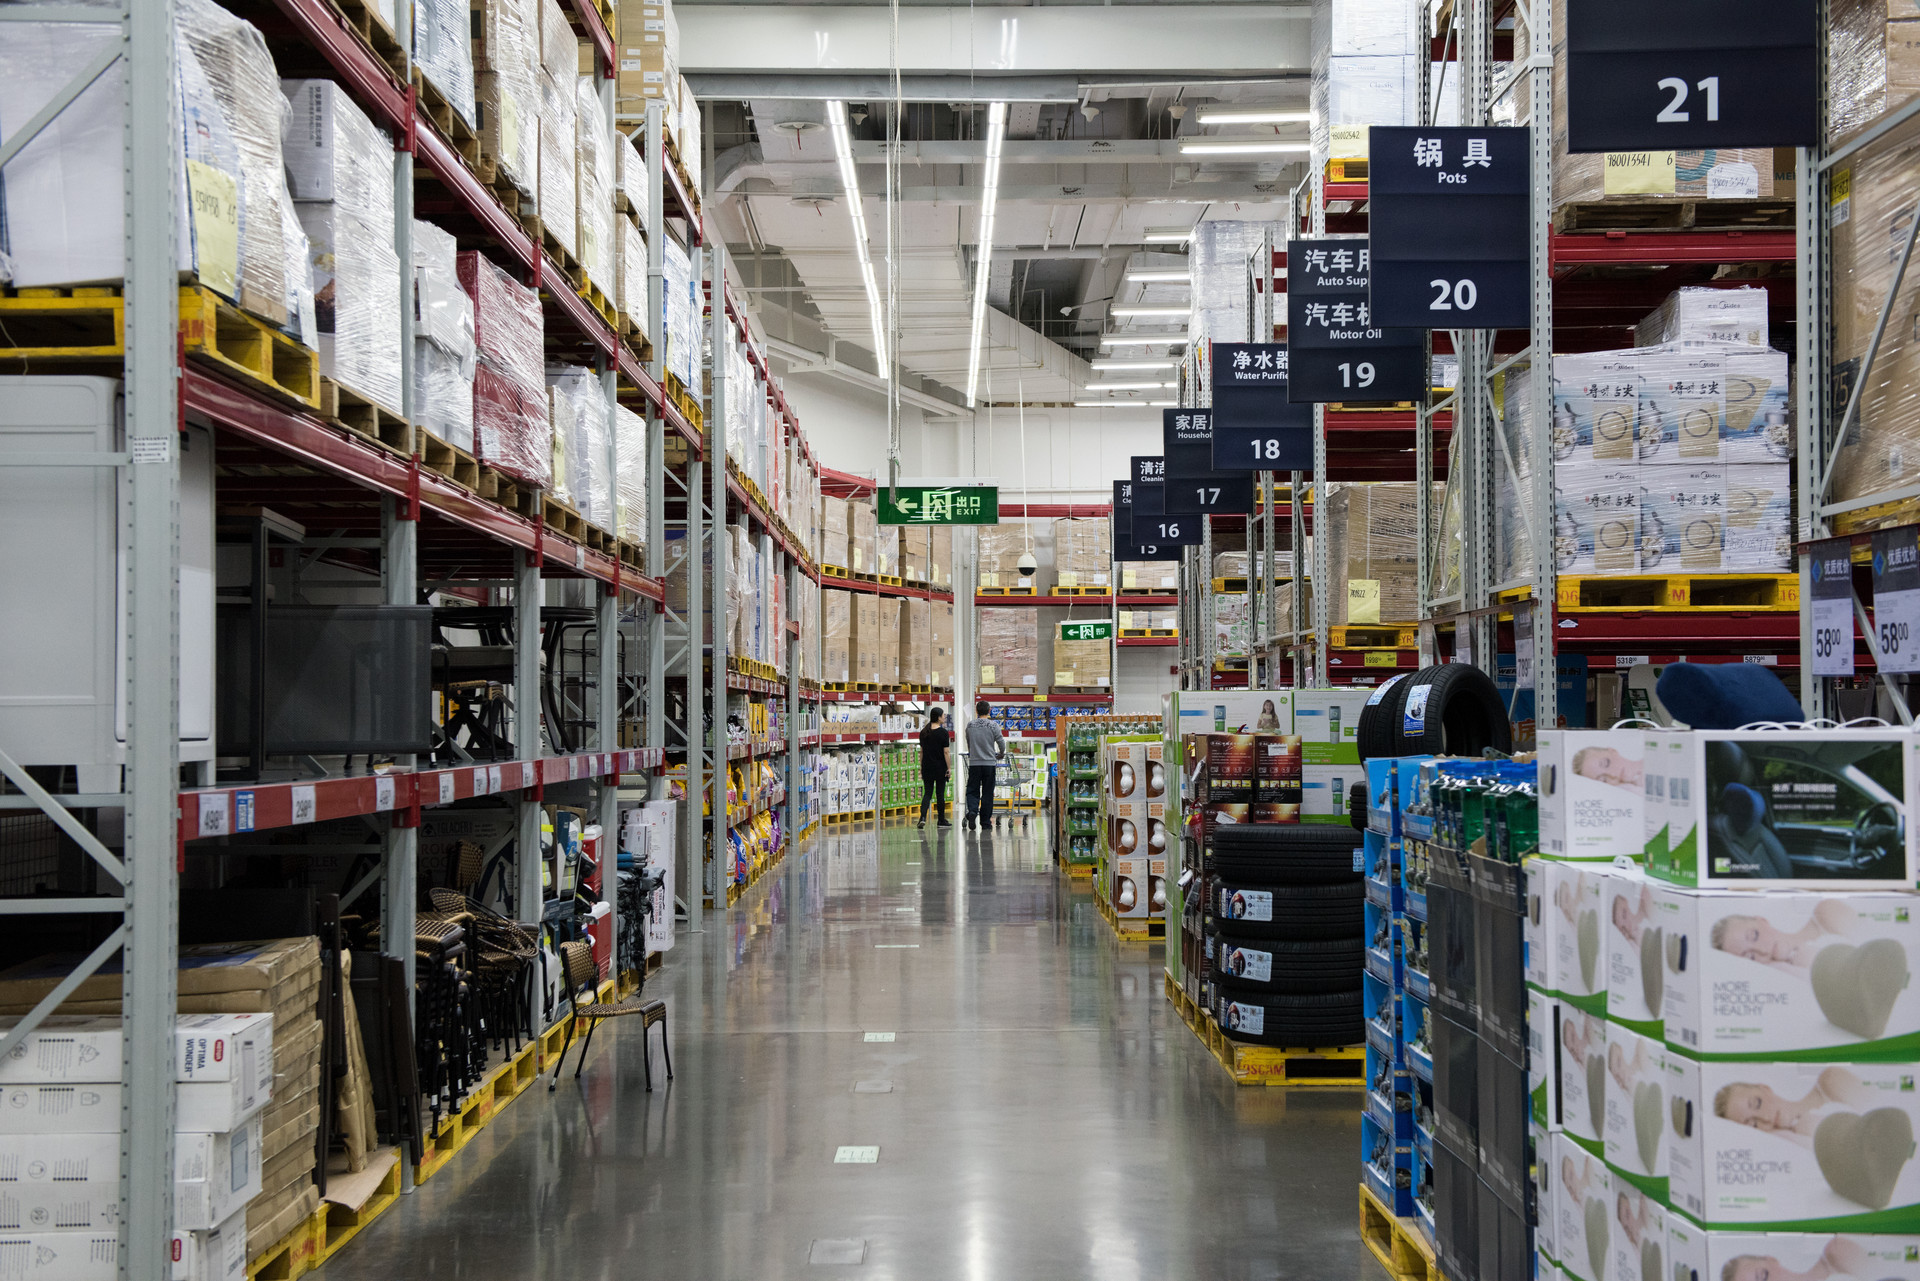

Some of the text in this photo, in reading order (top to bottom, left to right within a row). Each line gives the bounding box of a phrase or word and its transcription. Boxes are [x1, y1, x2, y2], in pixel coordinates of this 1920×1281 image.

[1657, 77, 1719, 122] 21
[1666, 154, 1674, 166] 6
[1438, 171, 1468, 184] Pots
[1317, 276, 1344, 286] Auto
[1429, 279, 1478, 311] 20
[1329, 328, 1382, 339] Motor Oil
[1235, 371, 1260, 380] Water
[1338, 362, 1376, 388] 19
[1175, 414, 1212, 431] 家居
[1251, 439, 1281, 460] 18
[956, 496, 981, 508] 出口
[1197, 487, 1221, 505] 17
[956, 508, 981, 516] EXIT
[1158, 523, 1180, 538] 16
[1672, 589, 1686, 602] M
[1574, 801, 1602, 809] MORE
[1574, 809, 1633, 818] PRODUCTIVE
[1574, 818, 1614, 827] HEALTHY
[1713, 981, 1749, 993] MORE
[1713, 993, 1789, 1004] PRODUCTIVE
[1713, 1004, 1763, 1016] HEALTHY
[197, 1038, 207, 1070] OPTIMA
[1716, 1149, 1754, 1160] MORE
[1716, 1160, 1792, 1173] PRODUCTIVE
[1717, 1173, 1767, 1185] HEALTHY
